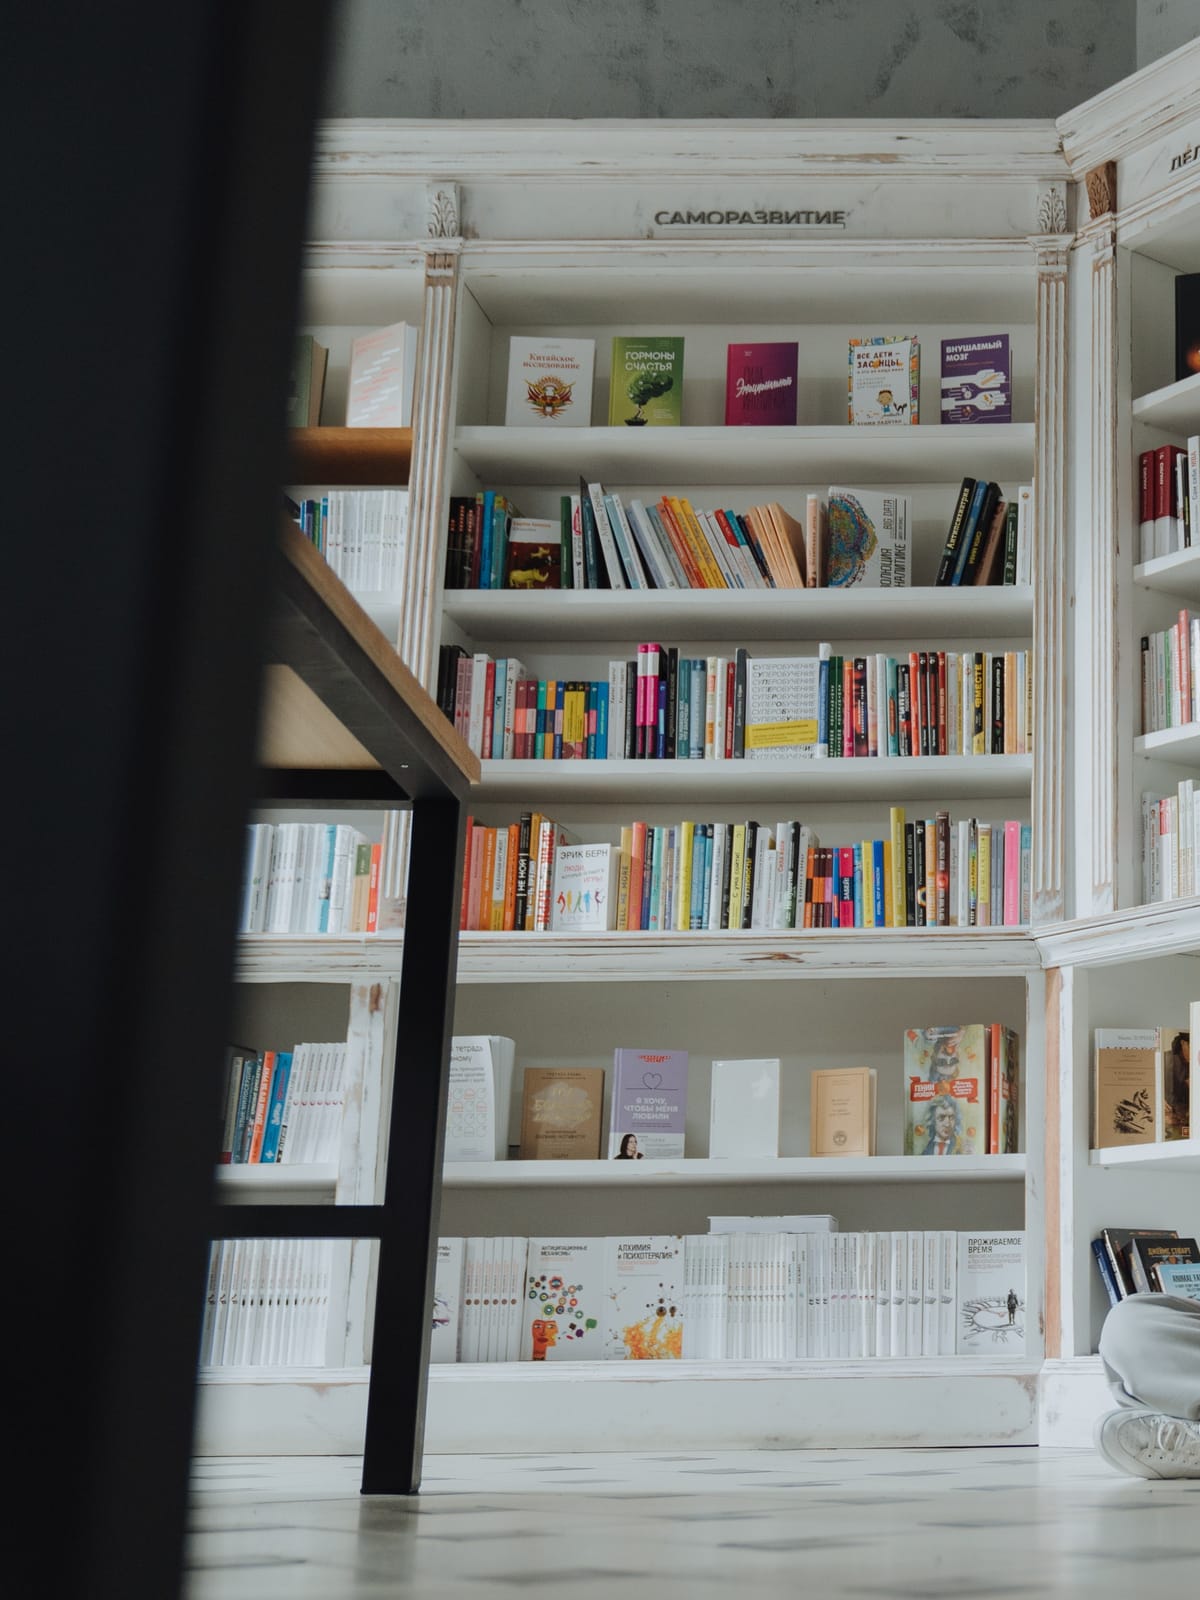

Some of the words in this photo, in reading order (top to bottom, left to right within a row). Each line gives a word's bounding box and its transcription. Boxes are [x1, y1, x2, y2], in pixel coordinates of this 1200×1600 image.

[654, 210, 847, 229] САМОРАЗВИТИЕ
[946, 340, 1003, 354] ВНУШАЕМЫЙ
[529, 353, 574, 362] Китайское
[625, 351, 675, 360] ГОРМОНЫ
[873, 351, 892, 359] ДЕТИ
[945, 353, 969, 362] МОЗГ
[522, 361, 580, 370] исследование
[625, 362, 672, 371] СЧАСТЬЯ
[883, 499, 893, 517] DATA
[560, 850, 583, 860] ЭРИК
[585, 848, 608, 858] БЕРН
[519, 858, 530, 878] НОЙ
[518, 879, 529, 892] НЕ
[624, 1104, 653, 1113] ЧТОБЫ
[631, 1113, 670, 1121] ЛЮБИЛИ
[968, 1238, 1022, 1246] ПРОЖИВАЕМОЕ
[968, 1246, 993, 1254] ВРЕМЯ
[623, 1252, 673, 1260] ПСИХОТЕРАПИЯ
